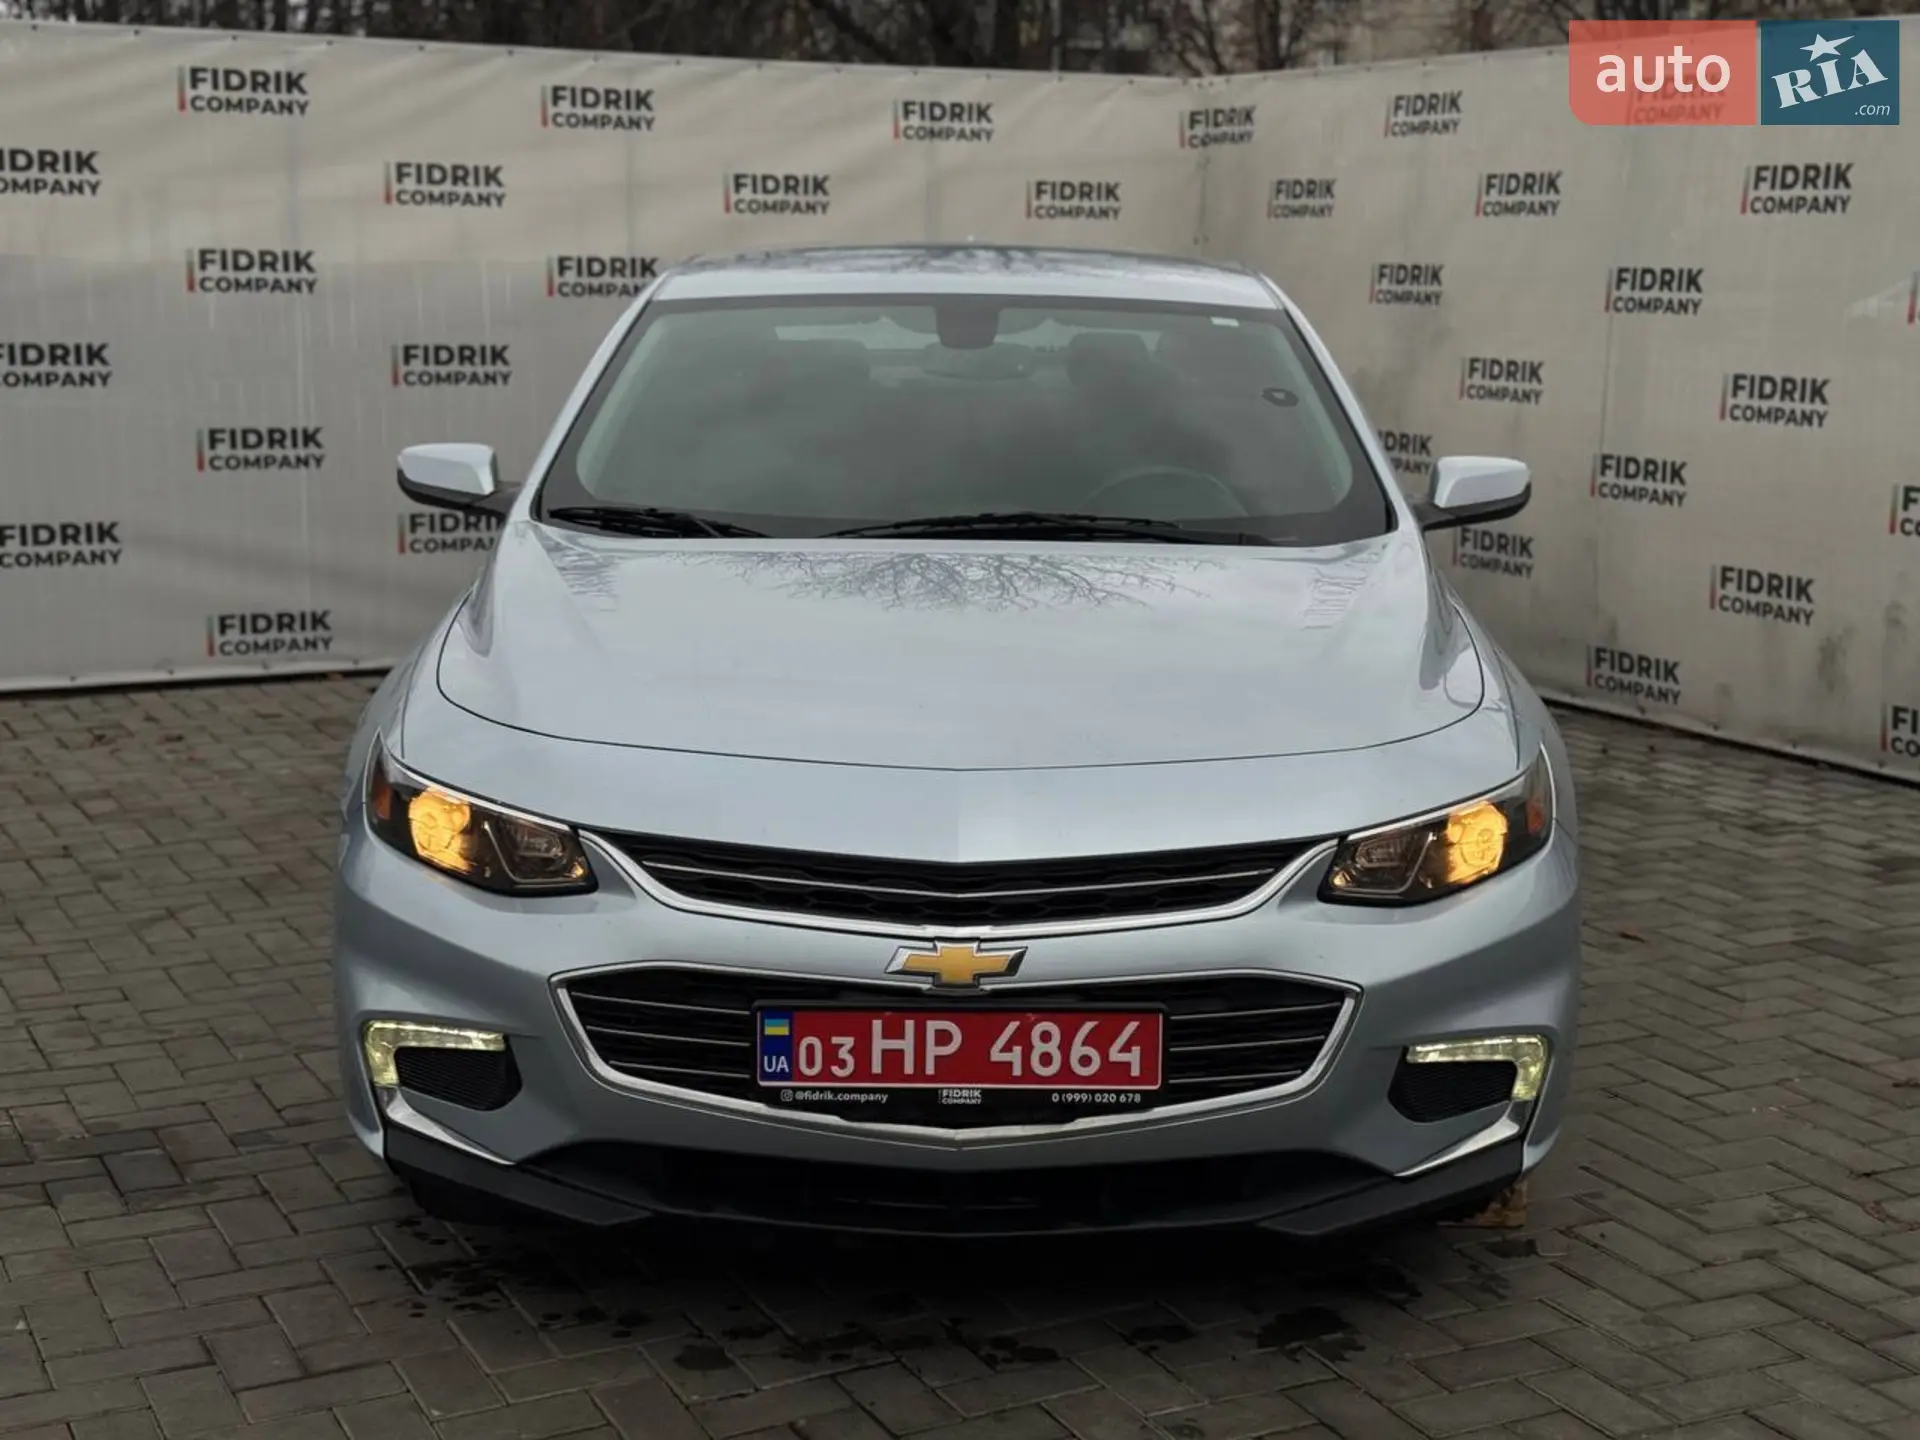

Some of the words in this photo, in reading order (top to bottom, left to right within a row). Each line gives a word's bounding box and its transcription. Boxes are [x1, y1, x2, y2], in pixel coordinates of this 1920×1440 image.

[189, 67, 308, 94] FIDRIK
[190, 96, 309, 115] COMPANY
[551, 86, 654, 111] FIDRIK
[1394, 91, 1463, 119] FIDRIK
[551, 112, 655, 131] COMPANY
[903, 101, 993, 124] FIDRIK
[1189, 107, 1256, 131] FIDRIK
[903, 126, 994, 143] COMPANY
[1392, 117, 1462, 137] COMPANY
[0, 148, 99, 174] IDRIK
[395, 163, 503, 188] FIDRIK
[734, 174, 829, 196] FIDRIK
[1485, 171, 1562, 197] FIDRIK
[1754, 163, 1852, 191] FIDRIK
[0, 178, 102, 196] OMPANY
[1036, 181, 1120, 201] FIDRIK
[1275, 179, 1336, 201] FIDRIK
[395, 189, 505, 208] COMPANY
[734, 197, 829, 216] COMPANY
[1483, 199, 1559, 217] COMPANY
[1750, 193, 1850, 215] COMPANY
[1035, 204, 1121, 220] COMPANY
[1273, 202, 1334, 219] COMPANY
[198, 249, 316, 273] FIDRIK
[558, 256, 659, 278] FIDRIK
[199, 275, 317, 294] COMPANY
[1378, 264, 1444, 287] FIDRIK
[1615, 267, 1703, 295] FIDRIK
[1376, 288, 1442, 306] COMPANY
[1613, 296, 1702, 316] COMPANY
[0, 342, 110, 366] IDRIK
[403, 345, 509, 367] FIDRIK
[0, 371, 112, 387] OMPANY
[403, 368, 510, 386] COMPANY
[1468, 357, 1543, 386] FIDRIK
[1466, 383, 1543, 407] COMPANY
[1731, 374, 1829, 405] FIDRIK
[1729, 404, 1827, 428] COMPANY
[209, 428, 324, 450] FIDRIK
[1379, 430, 1432, 457] DRIK
[209, 453, 325, 471] COMPANY
[1600, 455, 1686, 486] FIDRIK
[1599, 481, 1685, 508] COMPANY
[0, 522, 120, 547] FIDRIK
[1461, 526, 1534, 560] FIDRIK
[0, 549, 122, 568] COMPANY
[1720, 567, 1813, 604] FIDRIK
[1718, 595, 1813, 626] COMPANY
[219, 611, 332, 636] FIDRIK
[219, 637, 332, 656] COMPANY
[1595, 648, 1679, 685] FIDRIK
[1594, 674, 1680, 706] COMPANY
[799, 1036, 855, 1077] 03
[871, 1019, 963, 1075] HP
[989, 1021, 1141, 1077] 4864
[764, 1055, 789, 1073] UA
[795, 1090, 888, 1104] @fidrik.company
[942, 1089, 981, 1097] FIDRIK
[1052, 1093, 1059, 1102] 0
[1062, 1093, 1092, 1103] (999)
[1095, 1093, 1116, 1103] 020
[1119, 1093, 1141, 1103] 678
